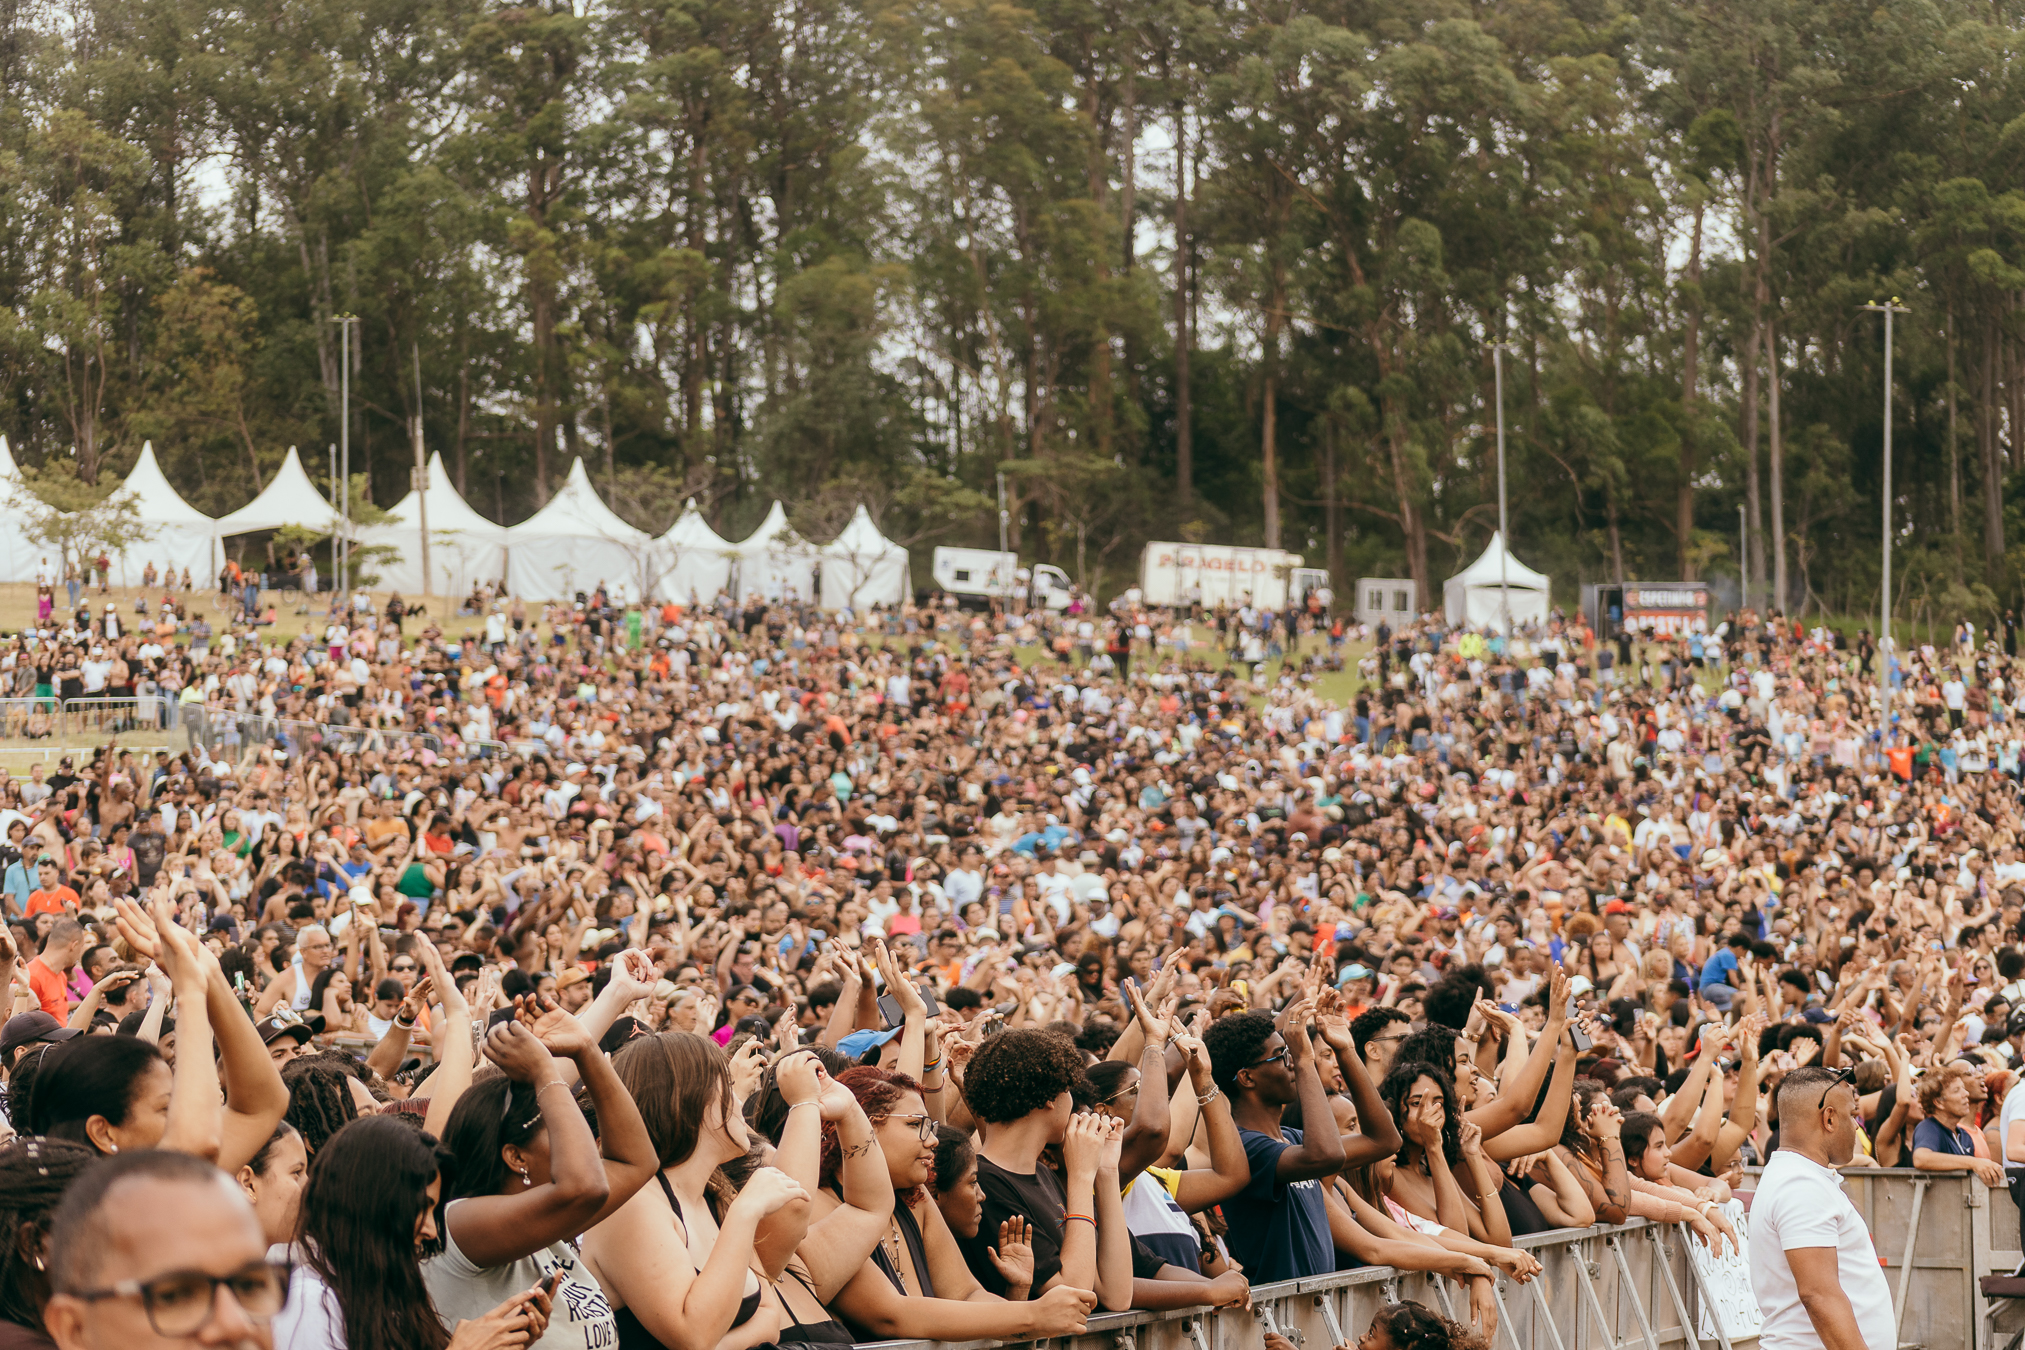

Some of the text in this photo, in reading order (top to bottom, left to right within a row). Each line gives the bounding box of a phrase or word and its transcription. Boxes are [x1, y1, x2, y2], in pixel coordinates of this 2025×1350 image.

[1158, 553, 1267, 573] PRAGELO
[1639, 590, 1695, 607] ESPETINHO
[584, 1321, 611, 1349] LOVE
